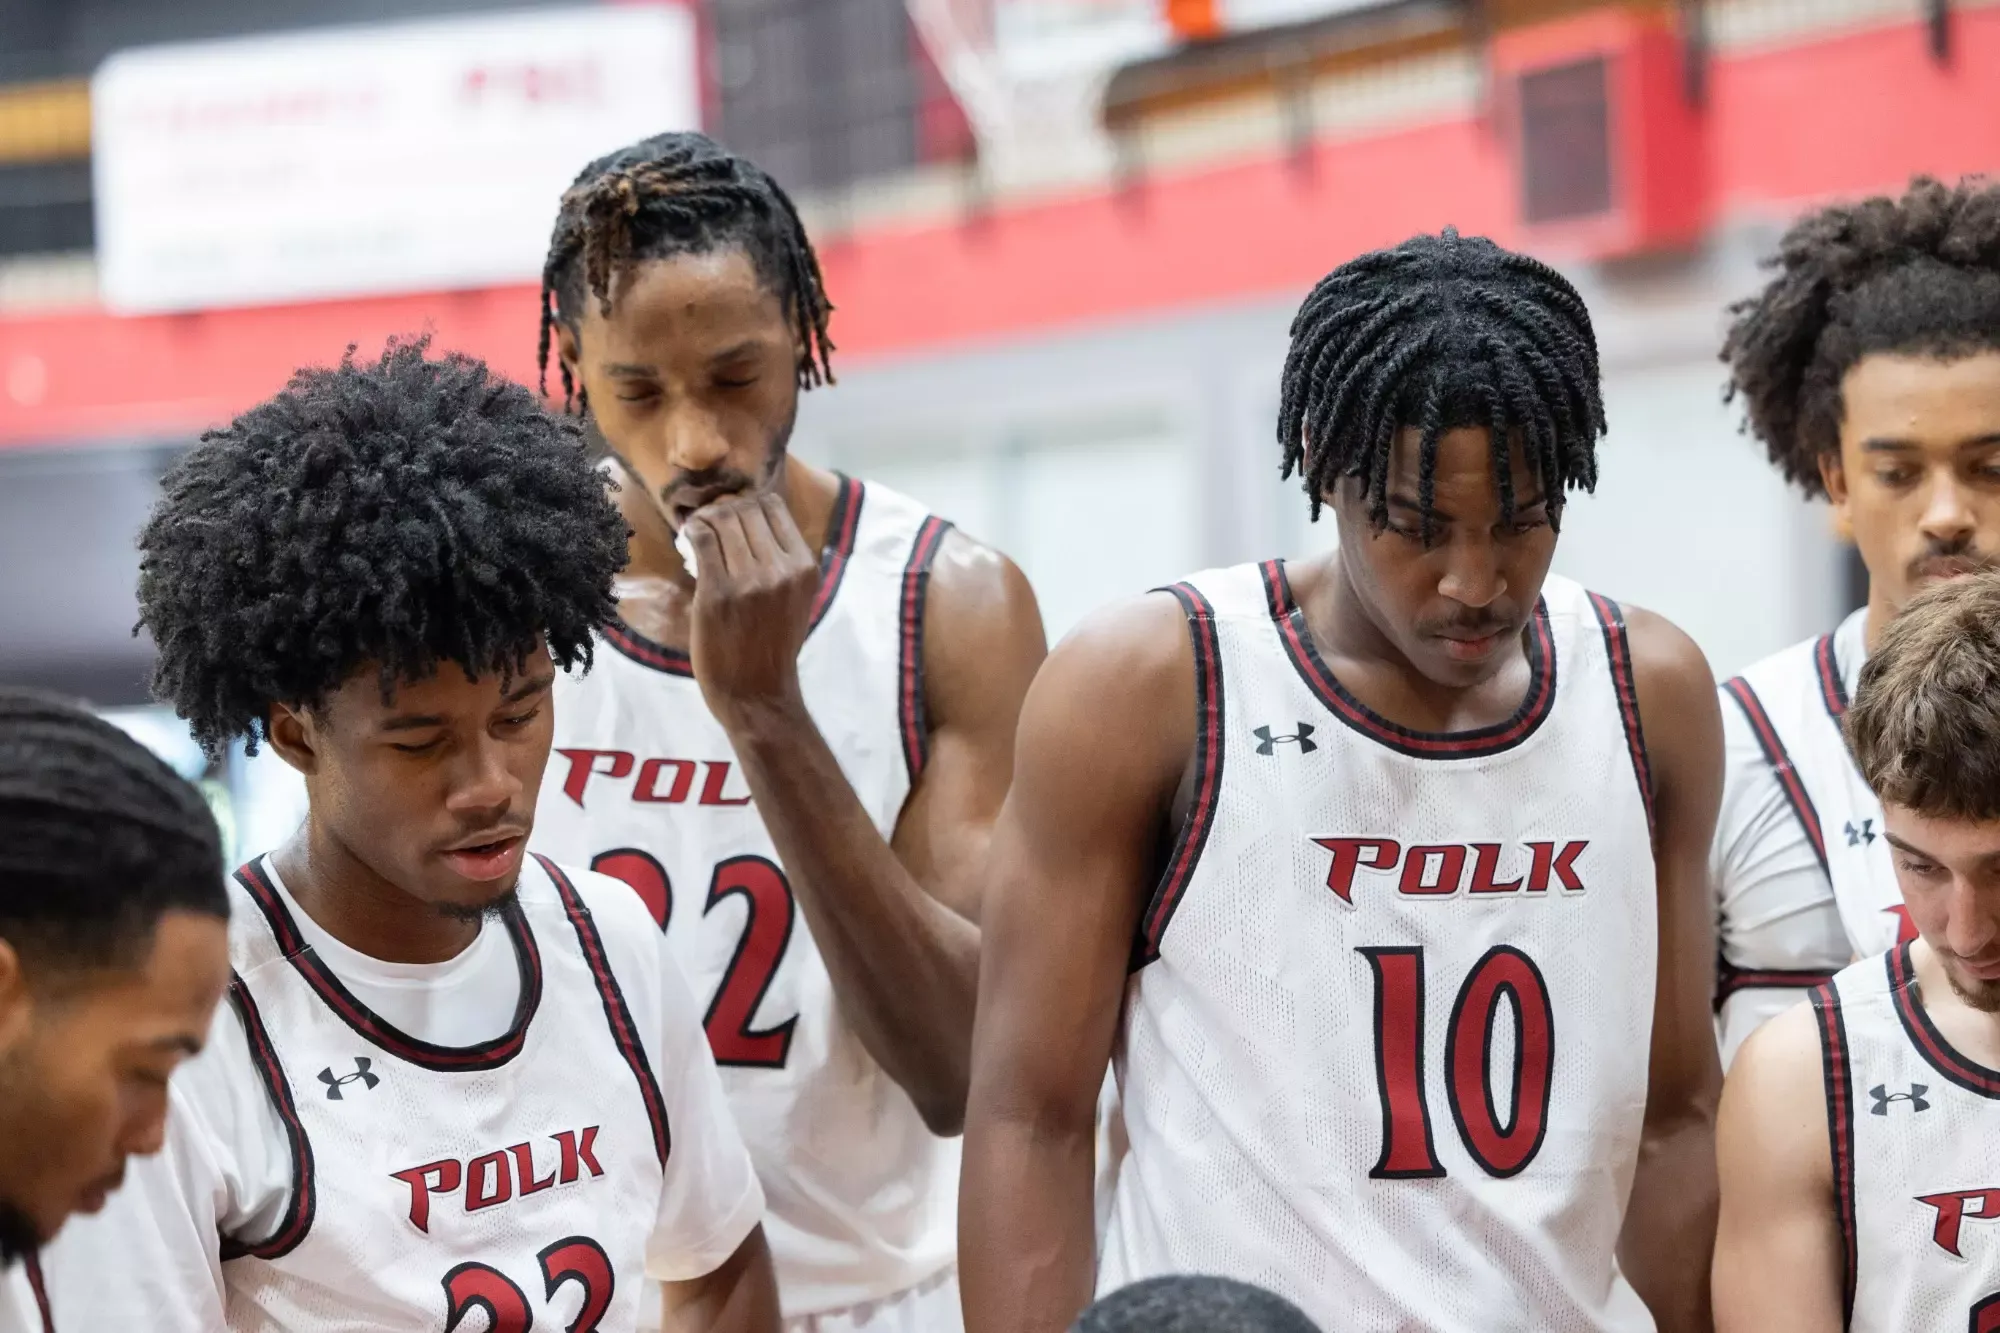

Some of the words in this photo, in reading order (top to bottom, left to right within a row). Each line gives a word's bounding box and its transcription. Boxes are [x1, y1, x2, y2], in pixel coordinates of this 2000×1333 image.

[553, 748, 752, 809] POL
[1308, 837, 1590, 907] POLK
[1352, 944, 1556, 1180] 10
[389, 1124, 605, 1235] POLK
